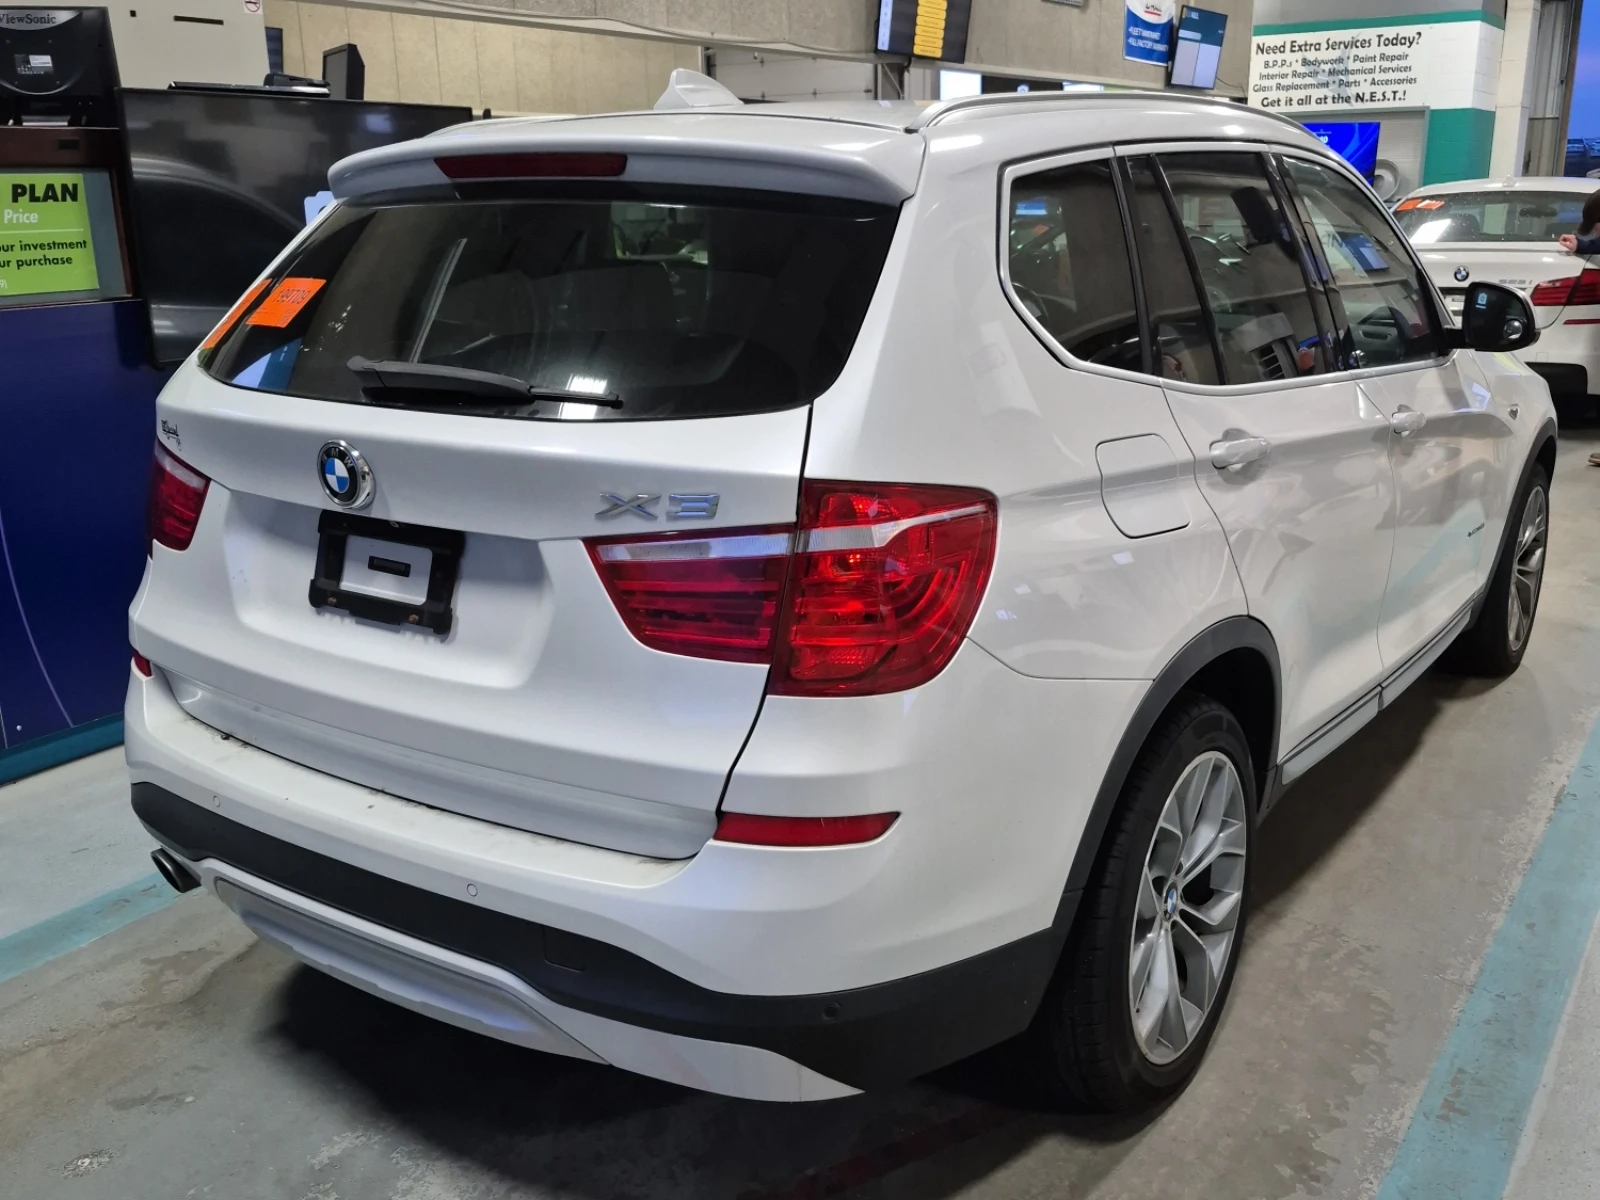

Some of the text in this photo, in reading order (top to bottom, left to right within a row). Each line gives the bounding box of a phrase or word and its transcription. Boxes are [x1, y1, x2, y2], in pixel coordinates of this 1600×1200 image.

[0, 13, 57, 24] ViewSonic
[1255, 32, 1422, 55] Need Extra Services Today?
[1300, 56, 1344, 68] Bodywork
[1352, 54, 1377, 64] Paint
[1379, 52, 1409, 62] Repair
[1259, 64, 1412, 81] Interior Repair Mechanical Services
[1252, 76, 1417, 93] Glass Replacement Parts Accessories
[1261, 90, 1407, 108] Get it all at the N.E.S.T.!
[11, 183, 78, 203] PLAN
[3, 208, 39, 224] Price
[19, 240, 87, 251] investment
[16, 254, 73, 270] purchase
[594, 493, 720, 521] X3
